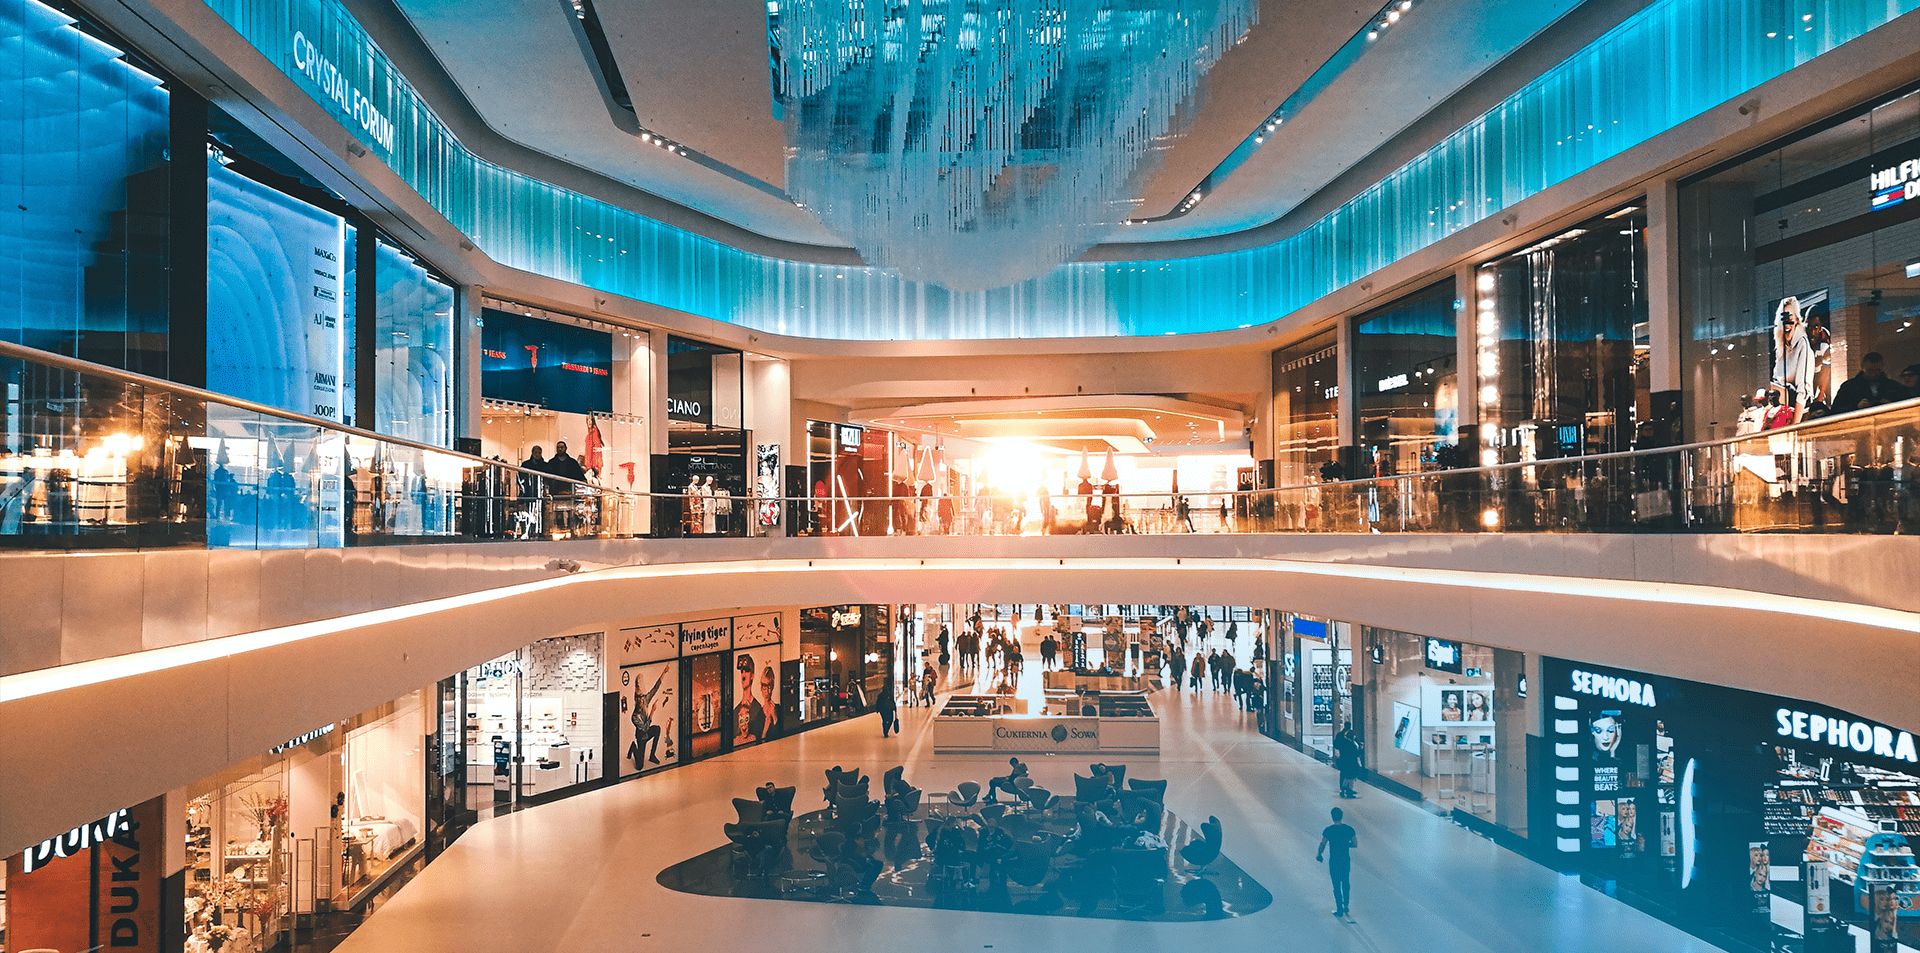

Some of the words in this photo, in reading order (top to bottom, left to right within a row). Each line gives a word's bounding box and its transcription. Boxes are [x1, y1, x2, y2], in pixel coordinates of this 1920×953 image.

[294, 30, 351, 115] CRYSTAL
[353, 87, 394, 155] FORUM
[1871, 158, 1920, 191] HILFI
[313, 404, 336, 418] JOOP!
[682, 628, 706, 645] flying
[706, 626, 728, 641] tiger
[690, 641, 719, 651] copenhagen
[1572, 669, 1656, 708] SEPHORA
[1776, 707, 1919, 763] SEPHORA
[1594, 766, 1618, 774] WHERE
[1594, 783, 1619, 792] BEATS
[111, 820, 141, 948] DUKA
